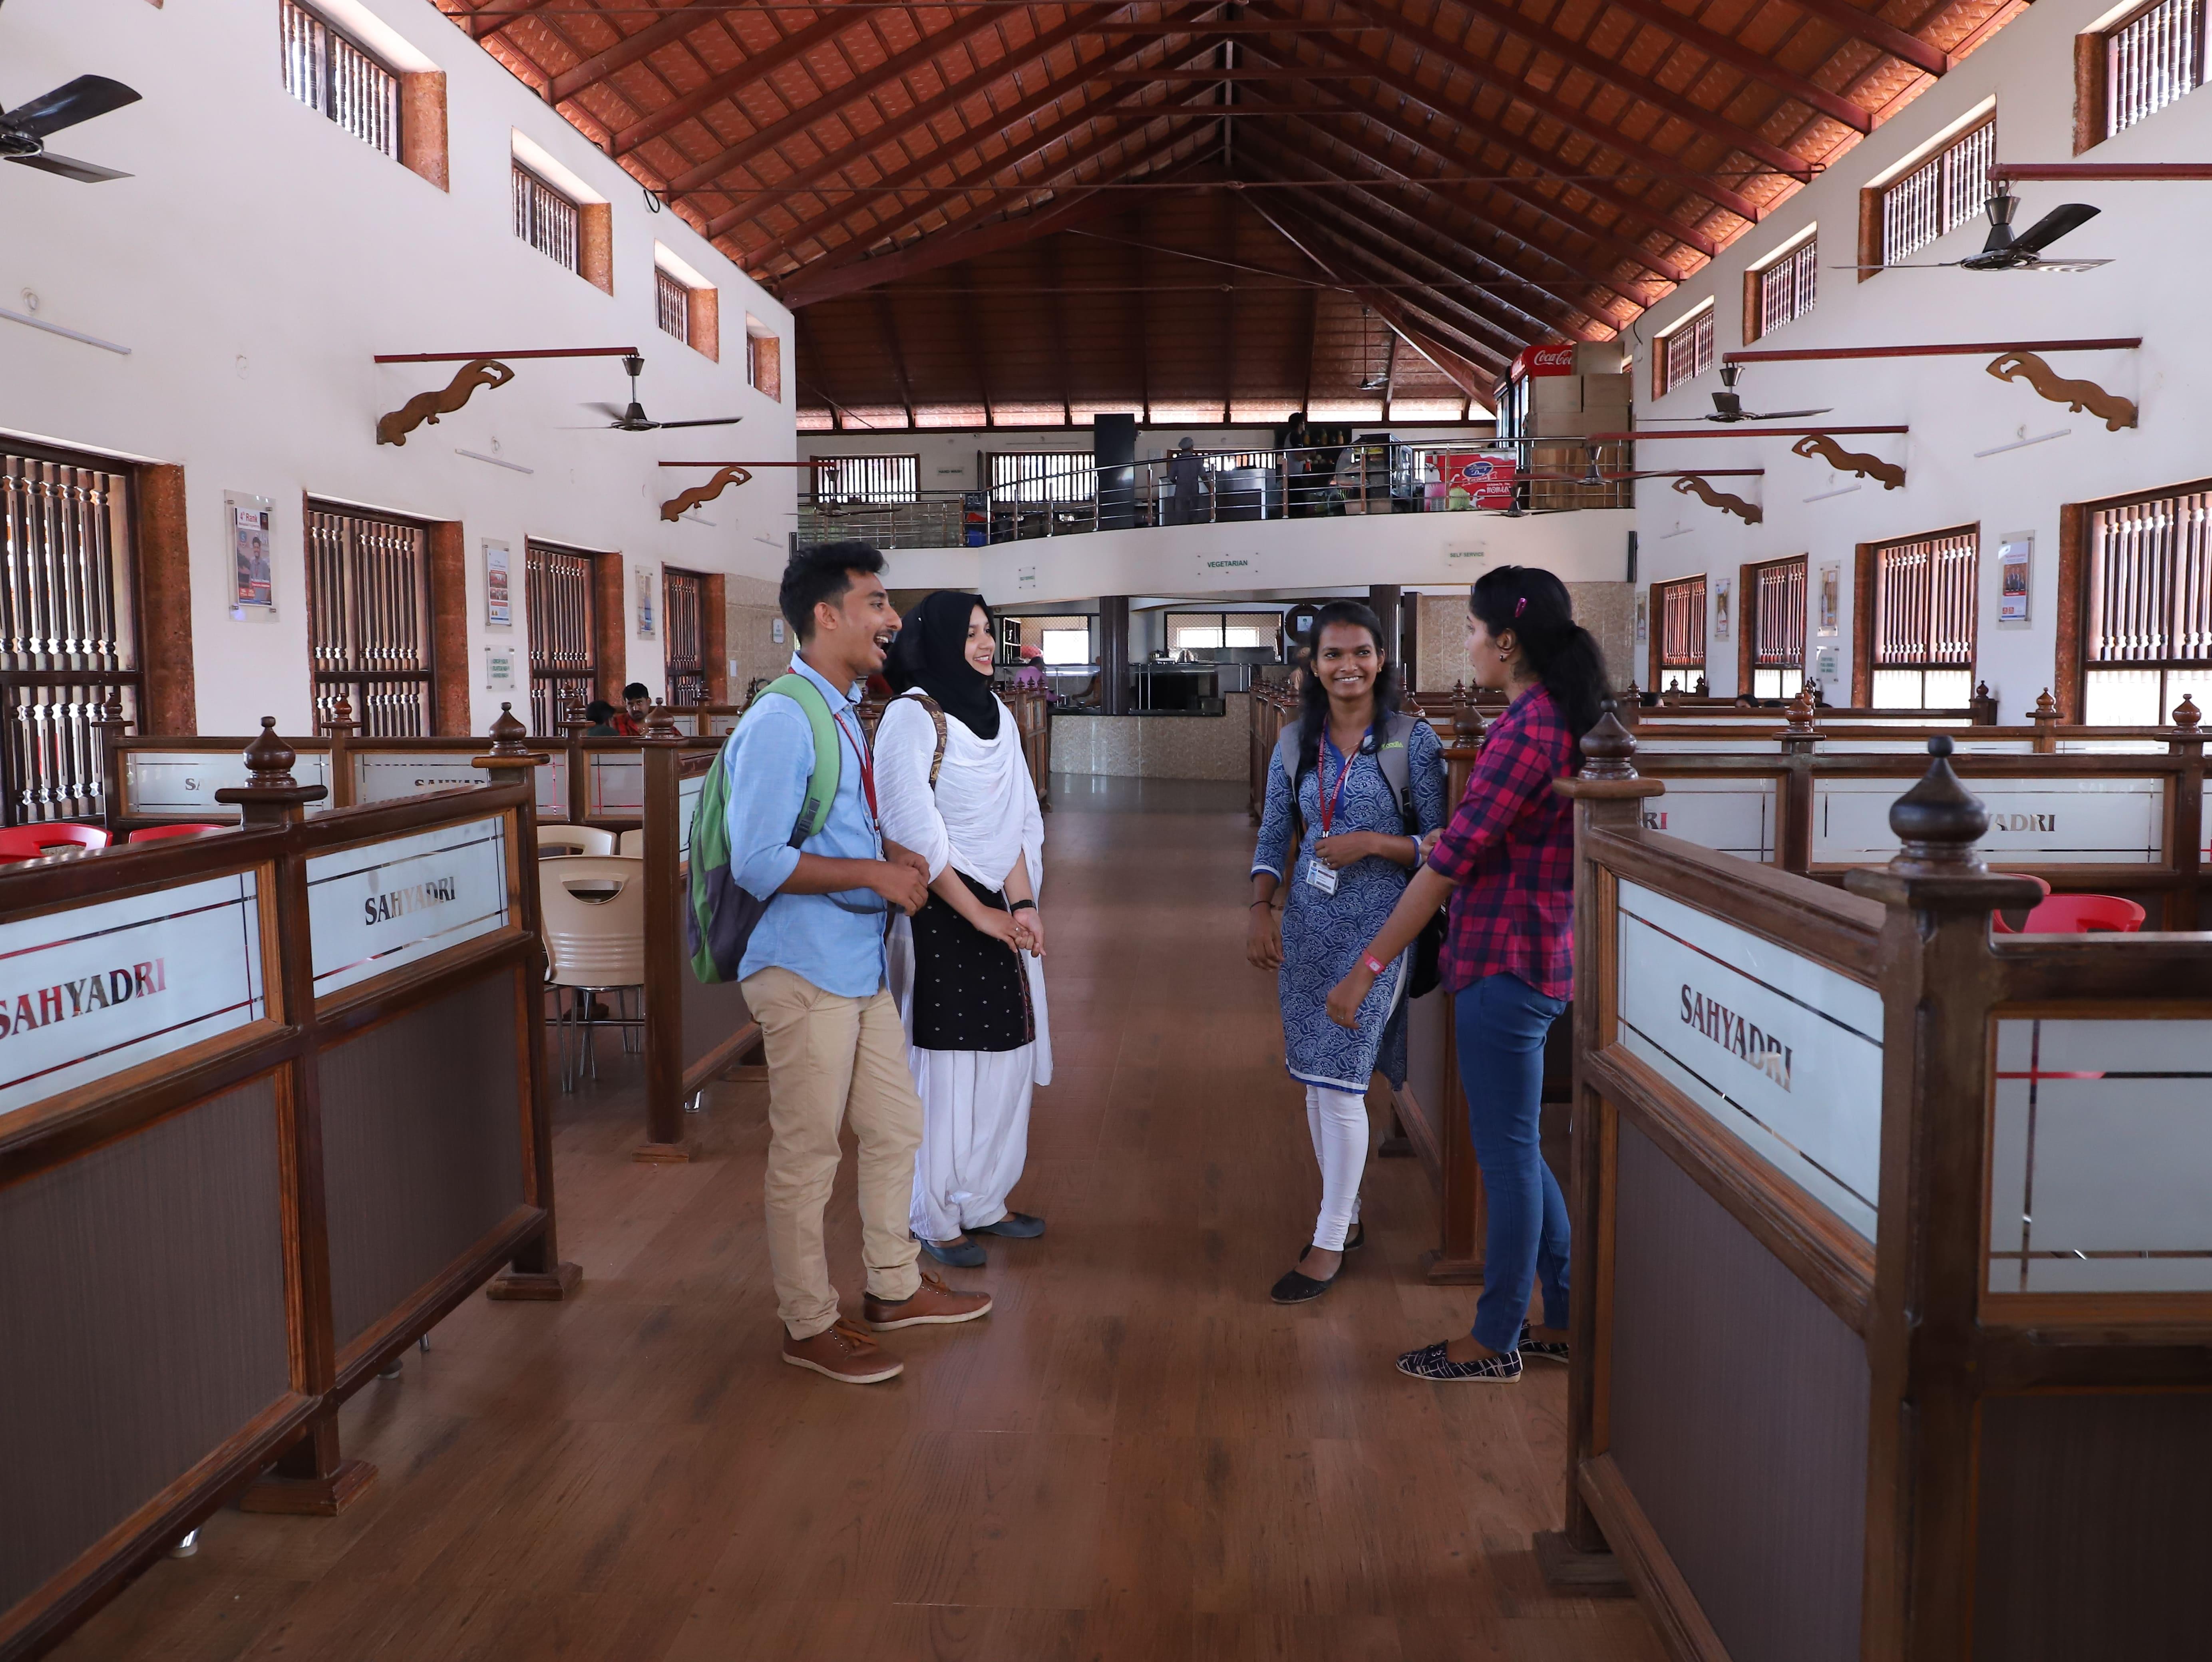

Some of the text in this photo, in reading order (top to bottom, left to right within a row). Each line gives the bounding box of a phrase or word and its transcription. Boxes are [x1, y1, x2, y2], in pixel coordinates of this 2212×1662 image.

[246, 513, 258, 523] Rank
[365, 876, 456, 926] SAHYADRI
[1681, 984, 1793, 1093] SAHYADRI
